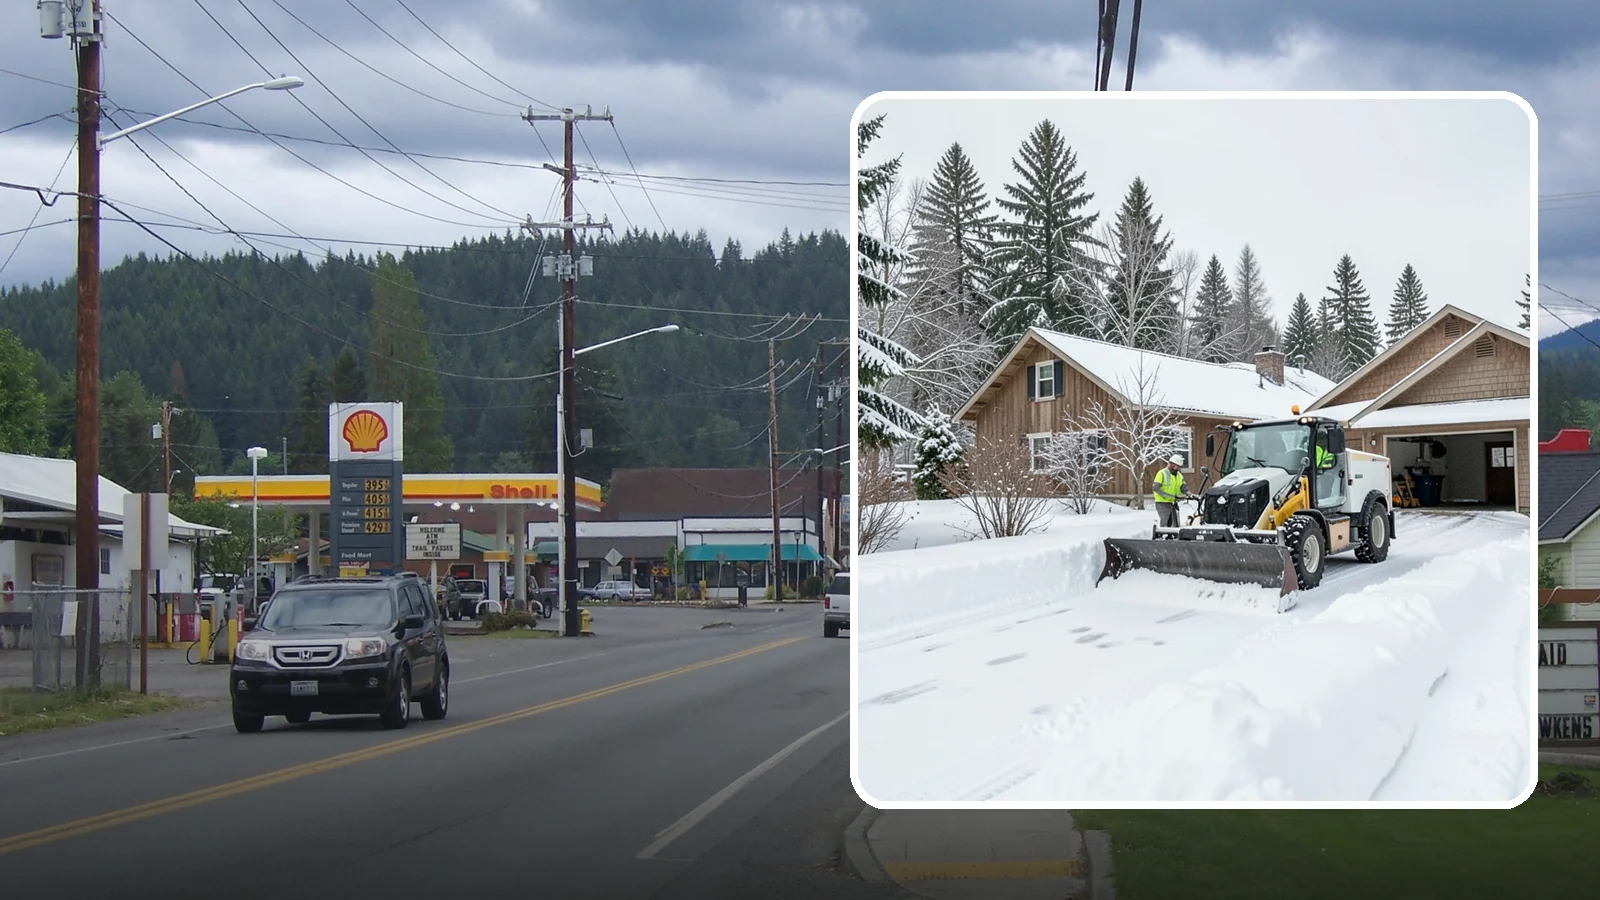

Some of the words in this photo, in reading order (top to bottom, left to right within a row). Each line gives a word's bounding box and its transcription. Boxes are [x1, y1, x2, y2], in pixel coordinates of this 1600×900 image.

[366, 480, 383, 490] 395
[490, 484, 547, 499] Shell
[365, 494, 383, 504] 405
[365, 508, 383, 517] 415
[365, 522, 383, 532] 429
